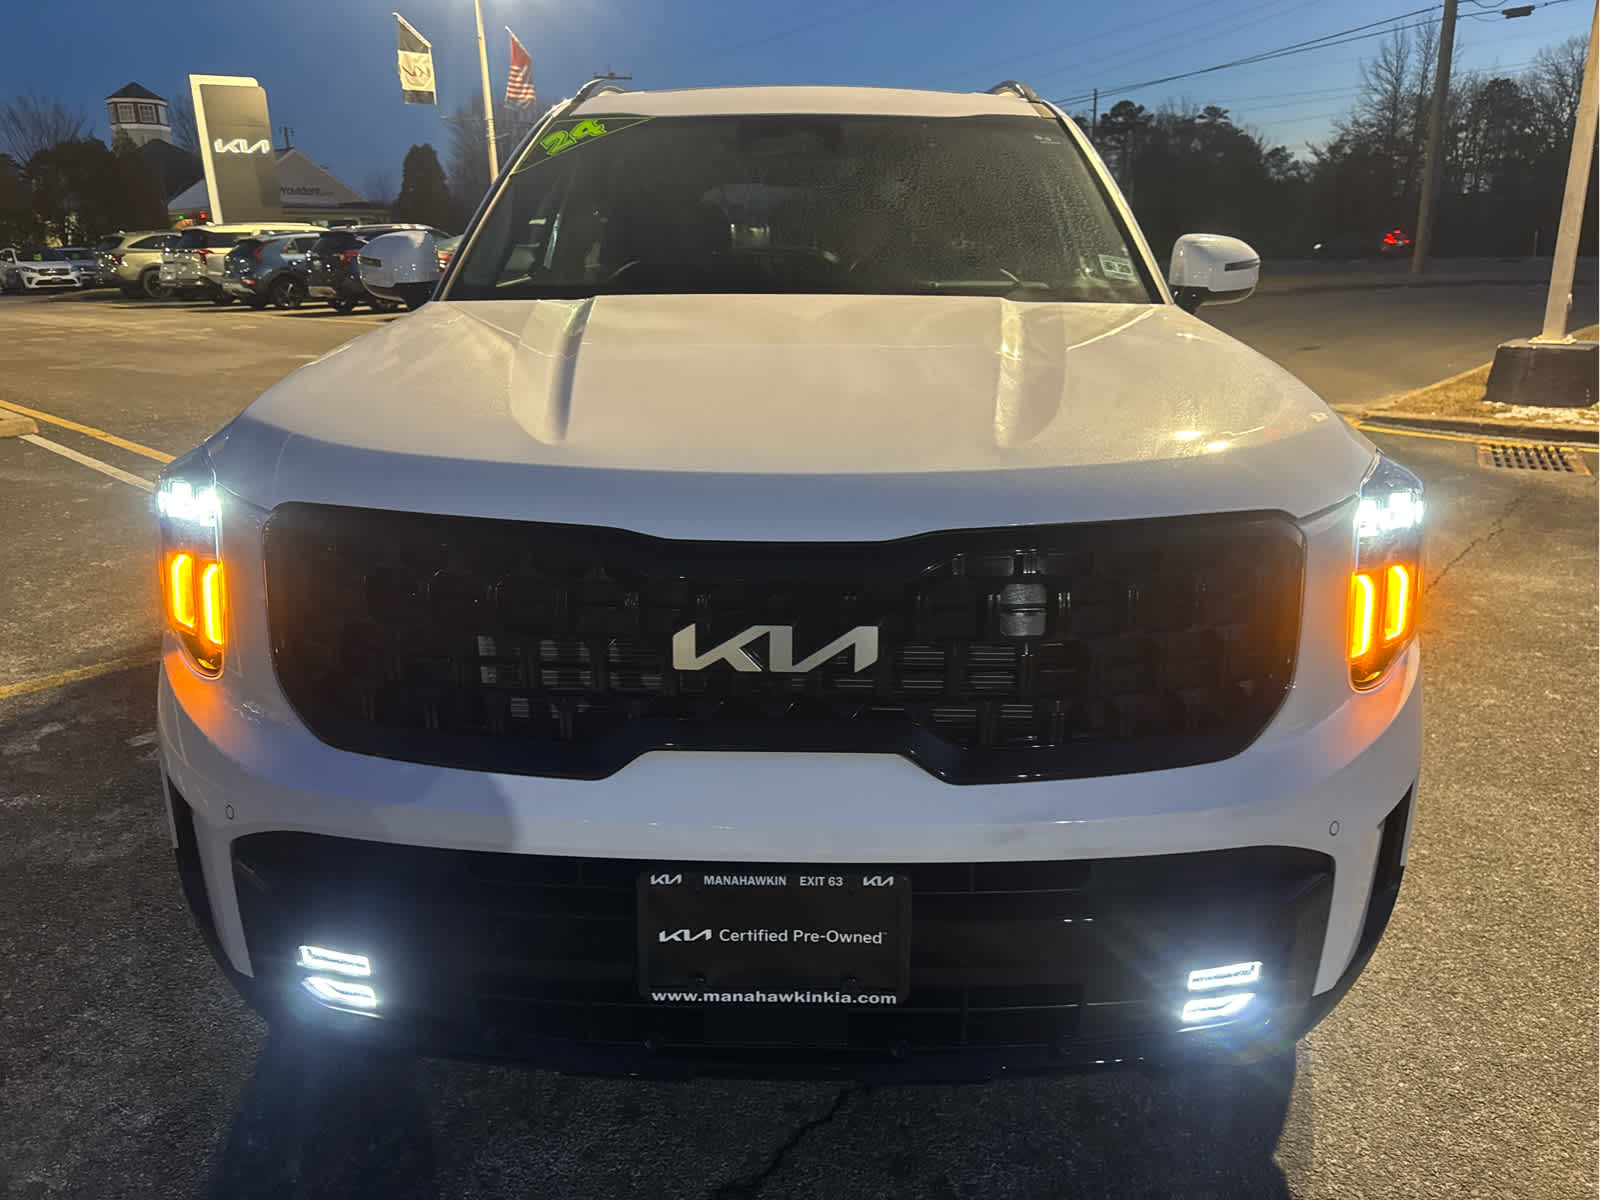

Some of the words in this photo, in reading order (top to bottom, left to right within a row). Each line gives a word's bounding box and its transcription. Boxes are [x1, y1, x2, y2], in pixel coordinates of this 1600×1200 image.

[540, 118, 608, 156] 24
[214, 138, 270, 154] KIA
[672, 623, 879, 673] KIA
[650, 873, 682, 885] KIA
[703, 875, 787, 887] MANAHAWKIN
[799, 876, 825, 887] EXIT
[828, 876, 844, 887] 63
[862, 875, 894, 887] KIA
[658, 929, 712, 943] KIA
[718, 928, 788, 943] Certified
[651, 991, 897, 1005] www.manahawkinkia.com
